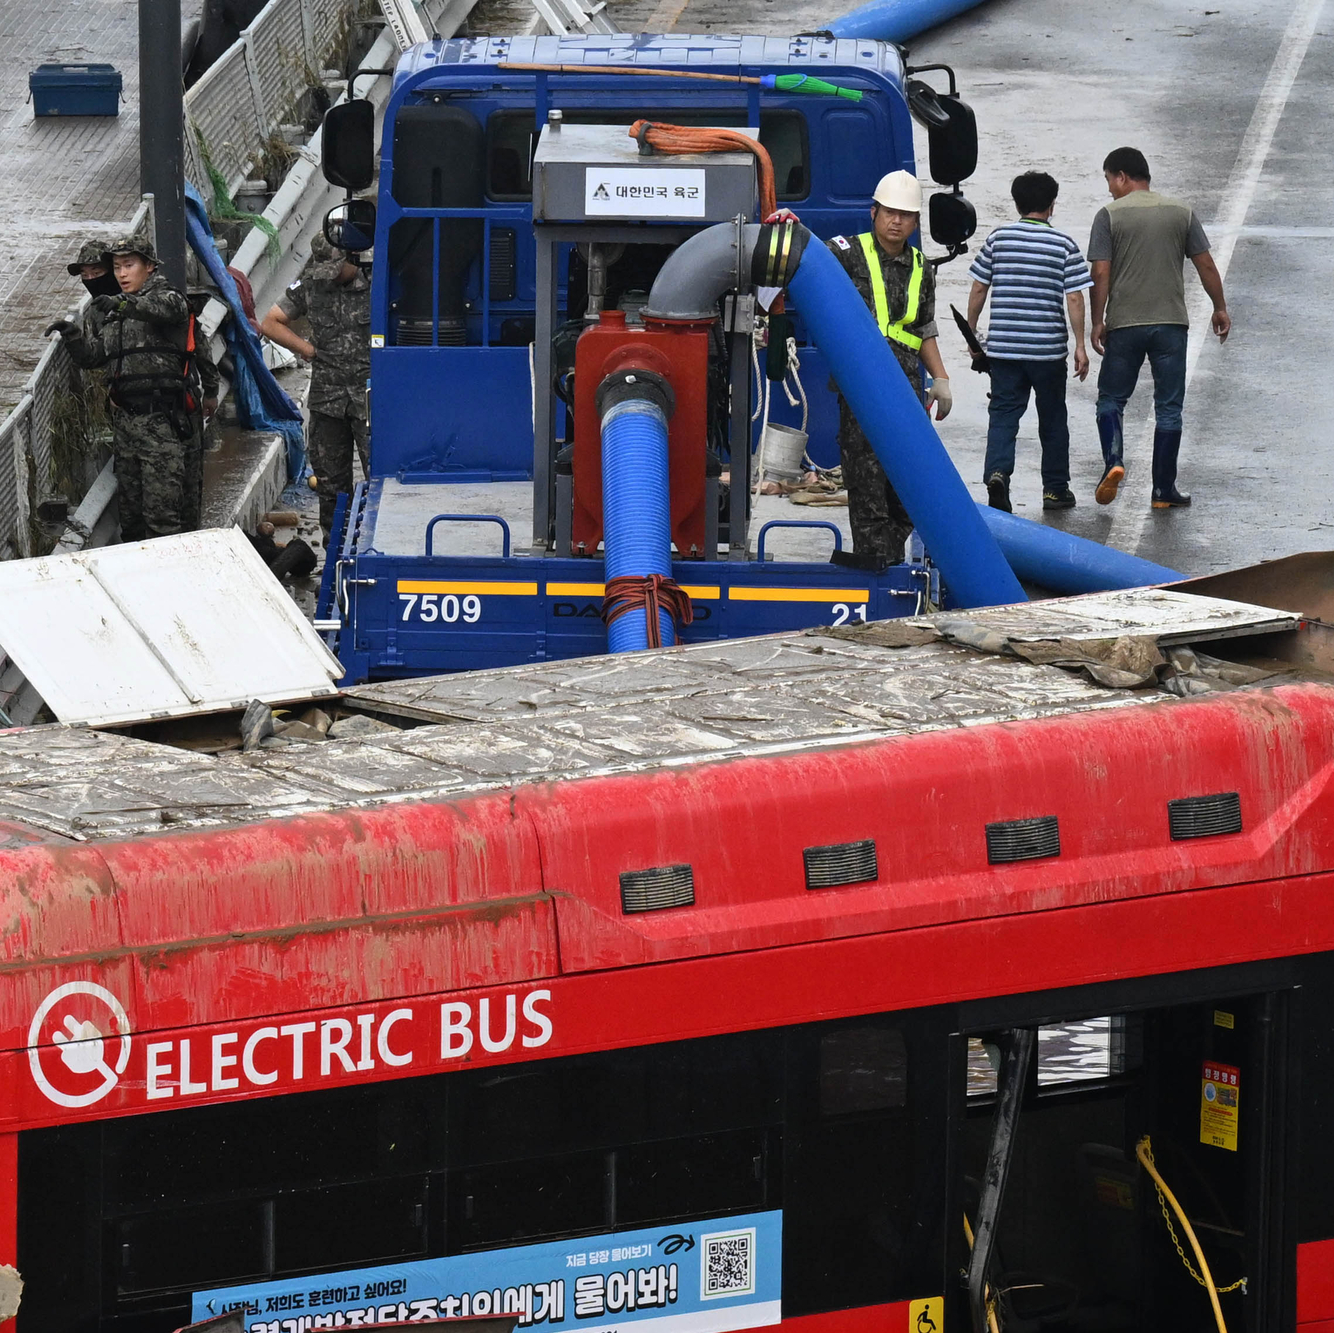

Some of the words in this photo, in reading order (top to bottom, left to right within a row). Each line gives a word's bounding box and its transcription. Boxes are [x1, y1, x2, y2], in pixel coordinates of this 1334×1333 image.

[615, 186, 668, 198] 대한민국
[673, 186, 699, 199] 육군
[398, 593, 483, 624] 7509
[146, 1008, 414, 1101] ELECTRIC
[440, 989, 553, 1059] BUS
[566, 1253, 586, 1268] 지금
[589, 1251, 609, 1265] 당장
[611, 1244, 652, 1262] 물어보기
[265, 1292, 305, 1313] 저희도
[308, 1286, 360, 1306] 훈련하고
[364, 1278, 407, 1299] 싶어요!
[575, 1263, 678, 1319] 물어봐!
